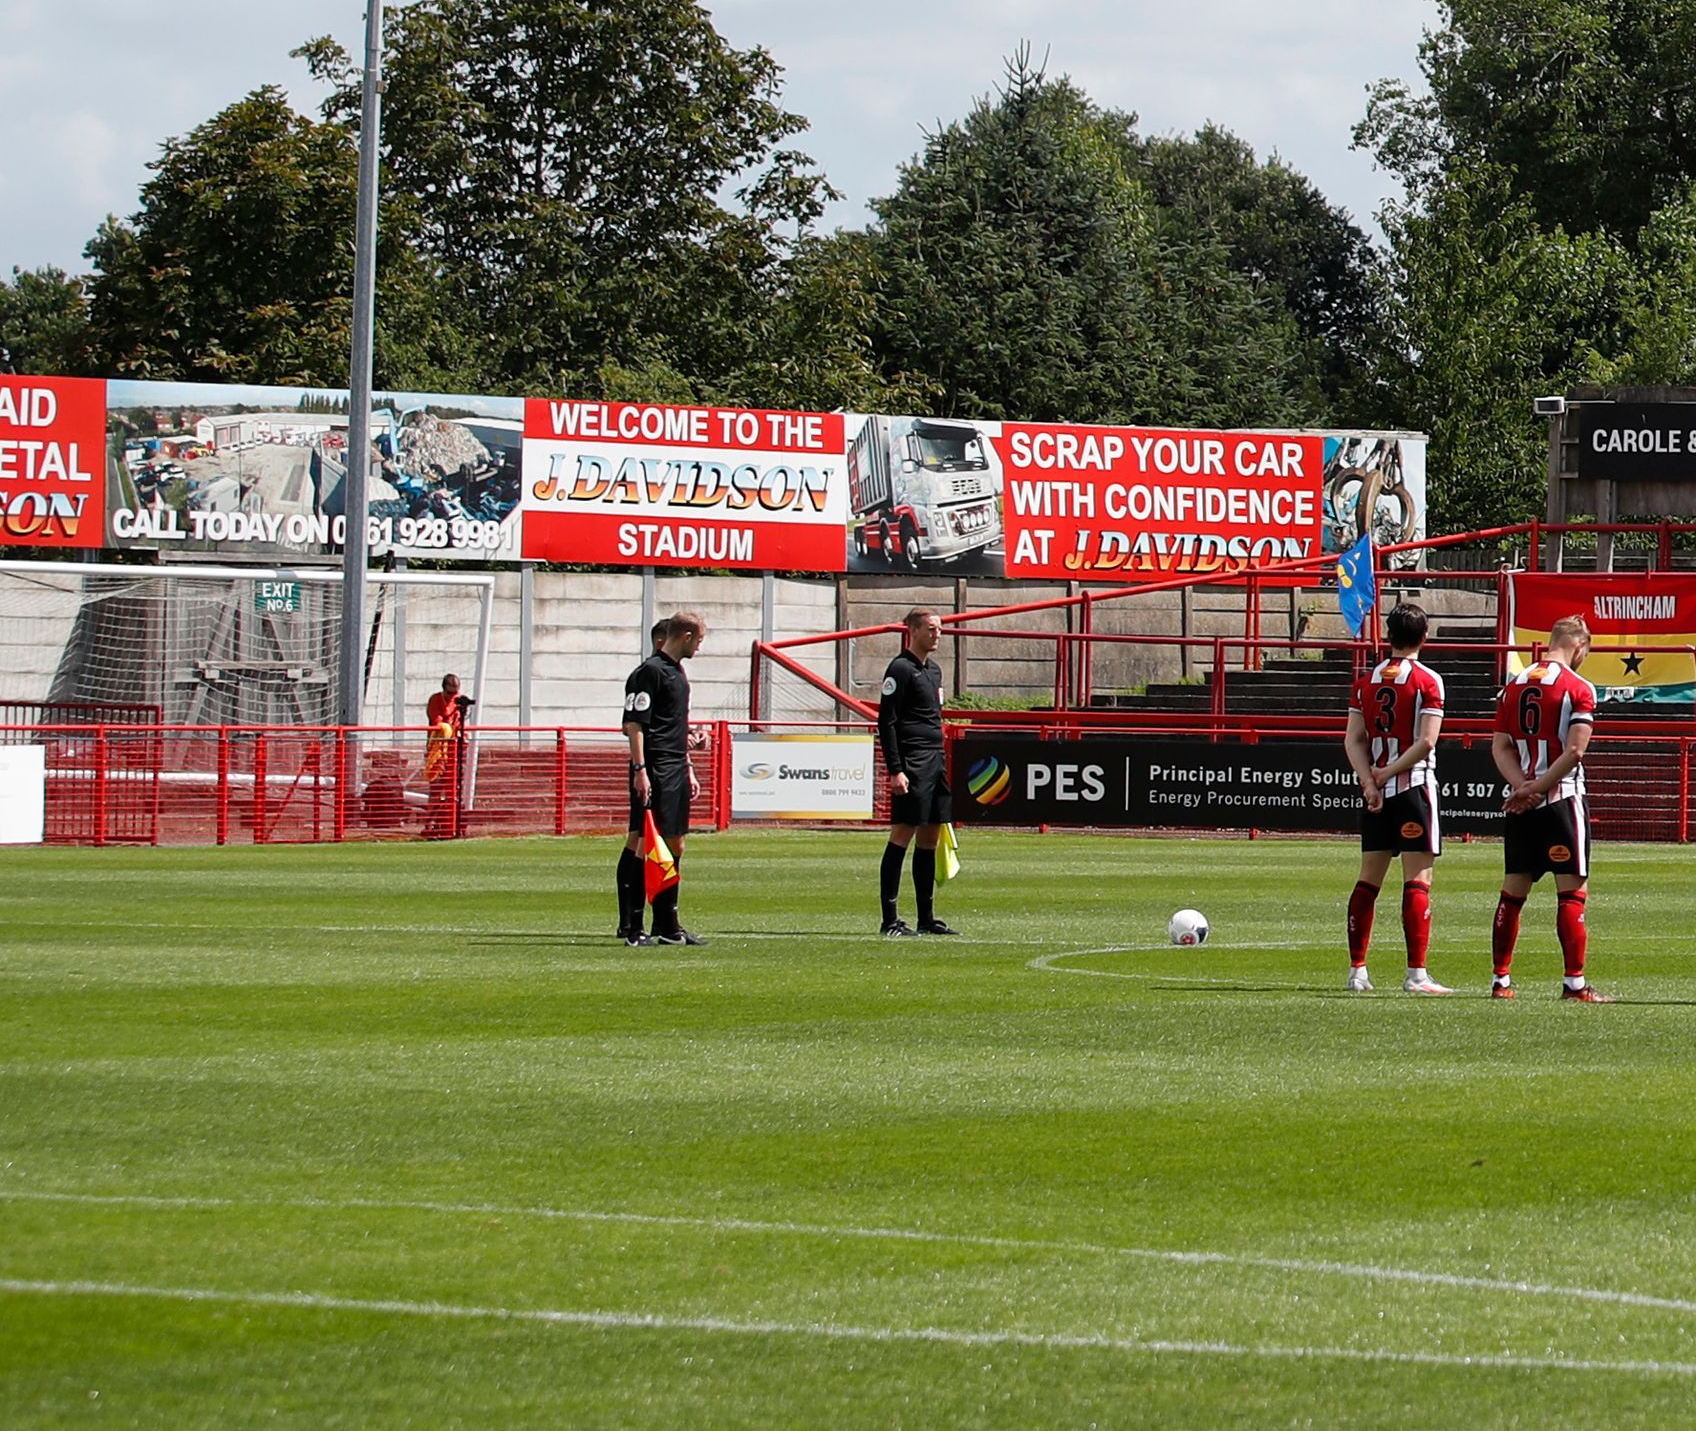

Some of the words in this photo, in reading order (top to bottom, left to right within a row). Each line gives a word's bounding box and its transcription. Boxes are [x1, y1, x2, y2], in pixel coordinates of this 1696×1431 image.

[550, 401, 708, 443] WELCOME
[718, 412, 759, 445] TO
[766, 415, 824, 448] THE
[1592, 429, 1682, 453] CAROLE
[1011, 431, 1125, 471] SCRAP
[1131, 437, 1226, 475] YOUR
[1234, 441, 1304, 477] CAR
[533, 453, 835, 512] J.DAVIDSON
[1011, 480, 1096, 517] WITH
[1104, 483, 1315, 524] CONFIDENCE
[113, 508, 186, 540] CALL
[189, 511, 284, 543] TODAY
[286, 514, 329, 544] ON
[331, 515, 394, 546] 061
[399, 518, 449, 548] 928
[451, 519, 515, 551] 9981
[618, 524, 753, 561] STADIUM
[1013, 529, 1055, 565] AT
[1065, 530, 1313, 573] J.DAVIDSON
[262, 581, 296, 598] EXIT
[1594, 594, 1676, 620] ALTRINCHAM
[1375, 686, 1397, 732] 3
[1518, 686, 1543, 735] 6
[1027, 763, 1105, 801] PES
[1150, 765, 1232, 787] Principal
[1241, 767, 1303, 788] Energy
[1311, 768, 1361, 786] Solut
[1467, 782, 1495, 798] 307
[1149, 789, 1201, 808] Energy
[1208, 791, 1306, 807] Procurement
[1313, 793, 1364, 810] Specia
